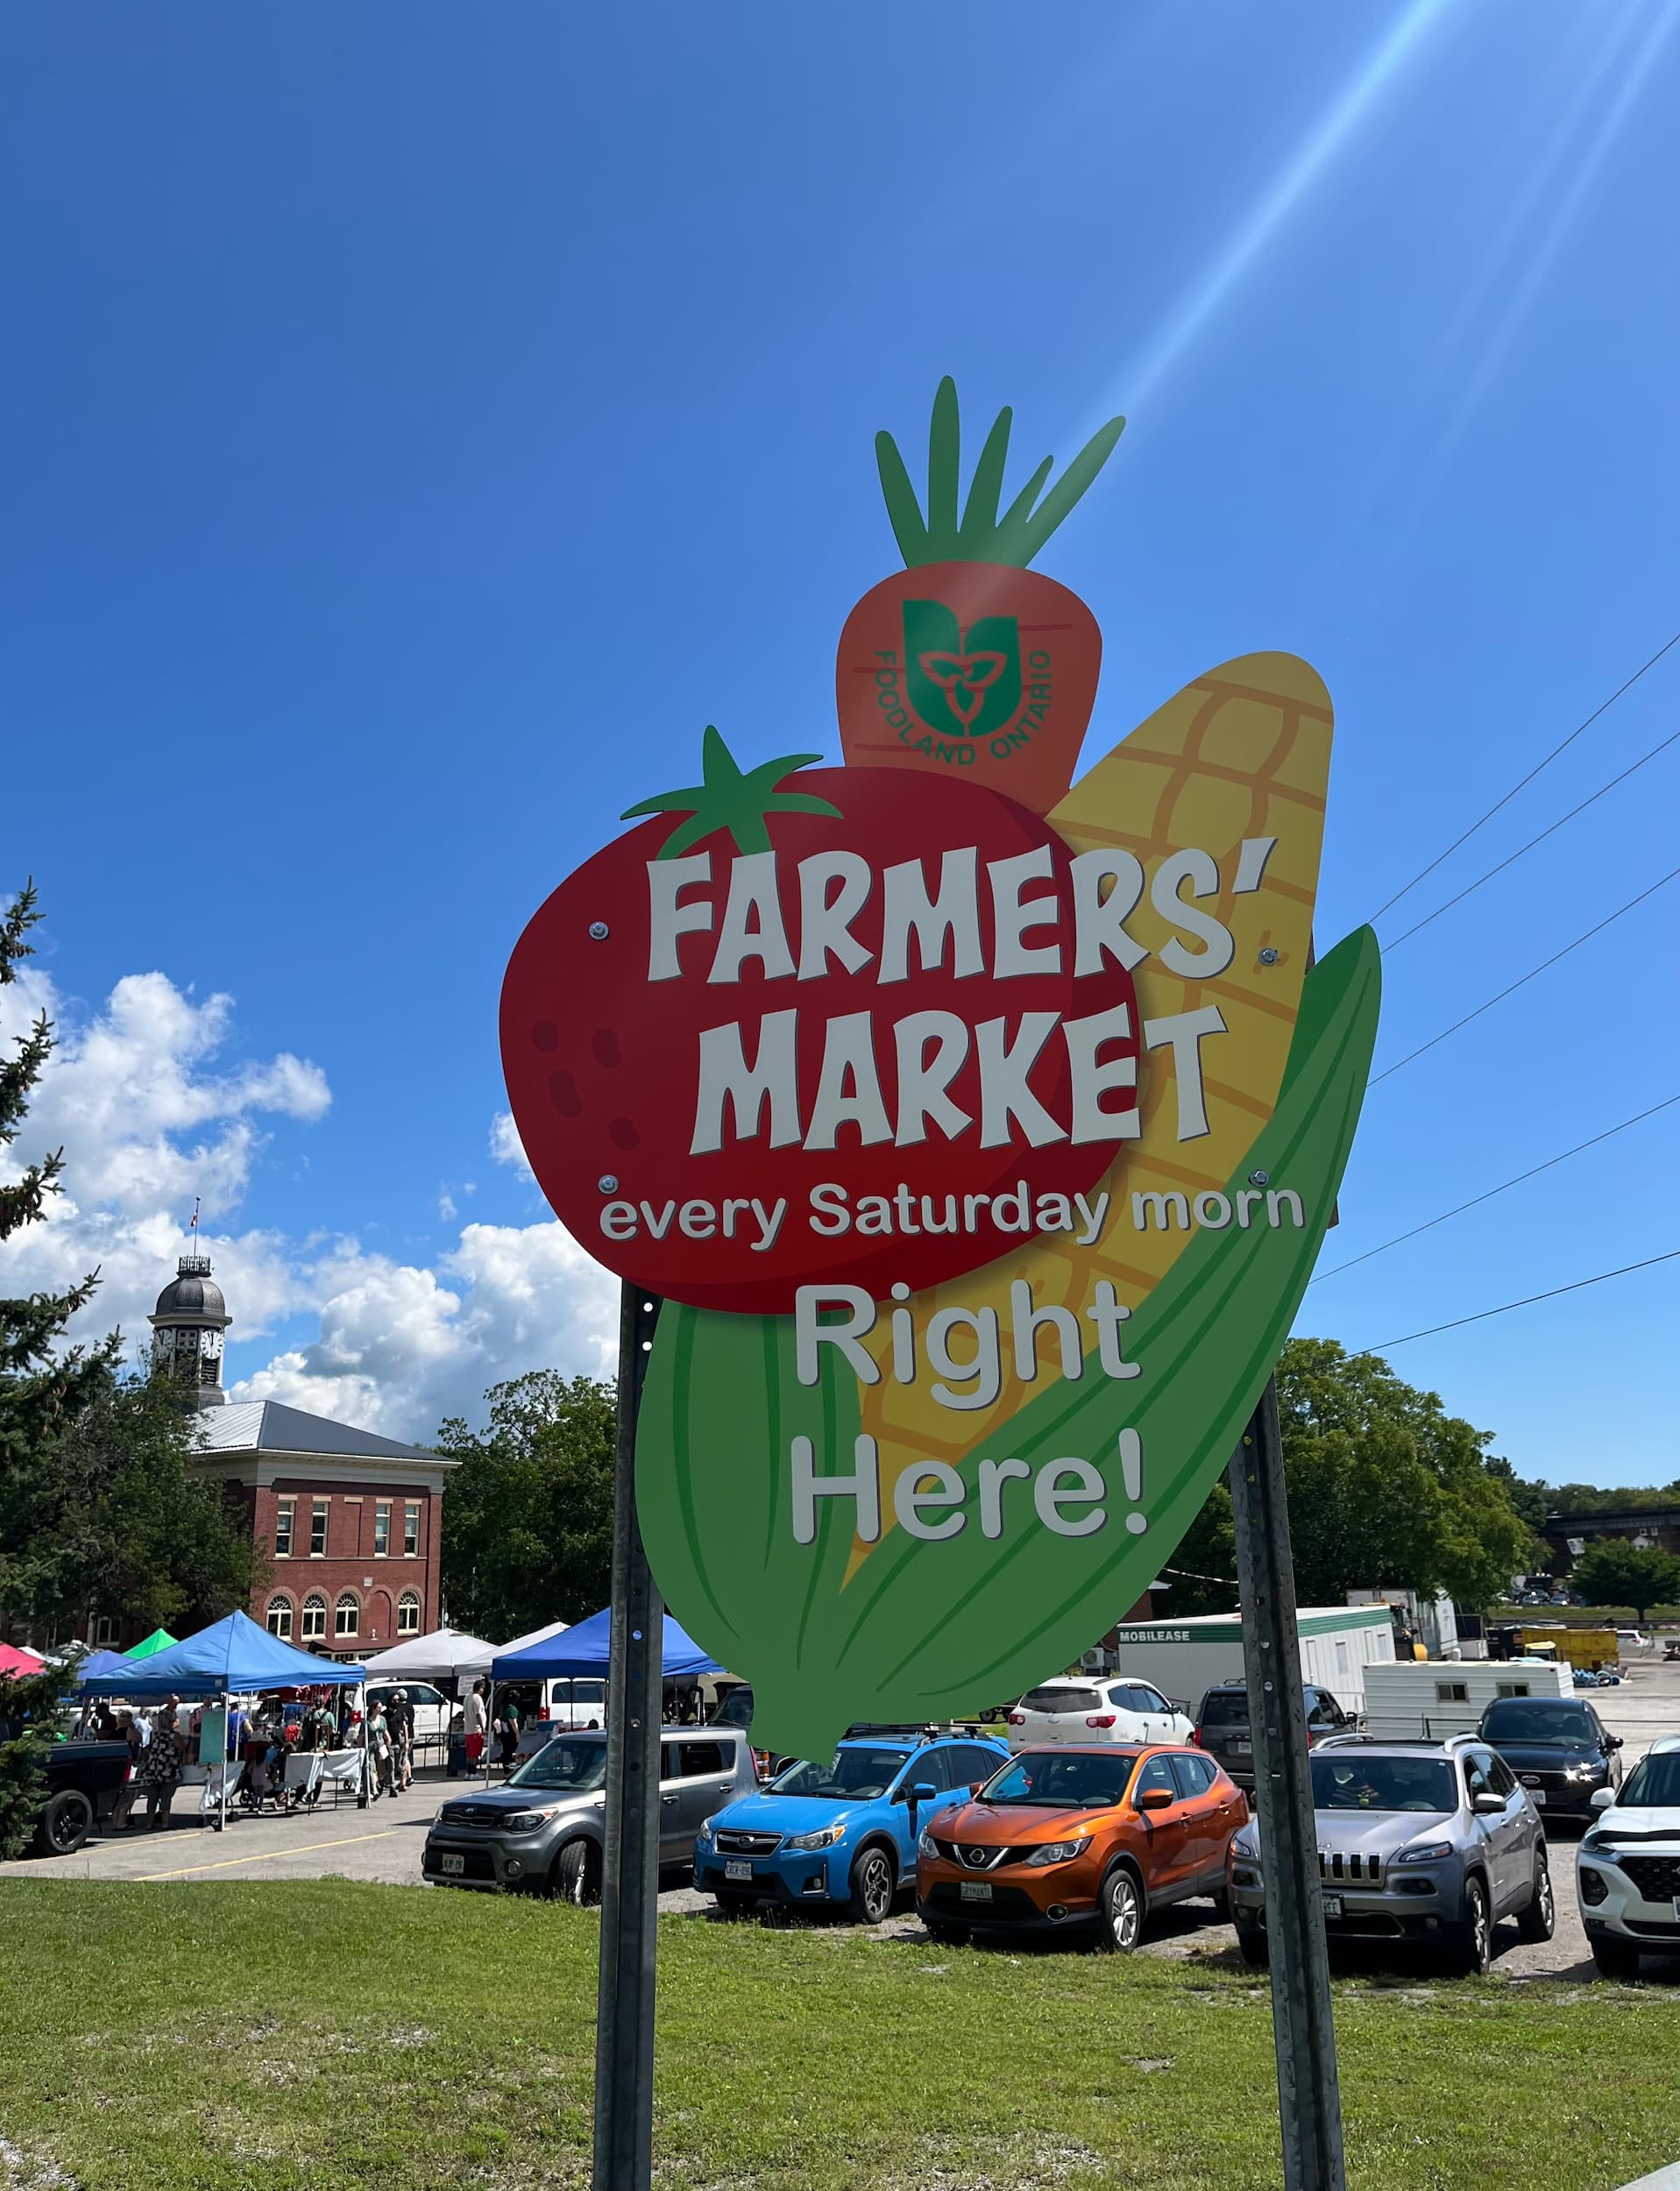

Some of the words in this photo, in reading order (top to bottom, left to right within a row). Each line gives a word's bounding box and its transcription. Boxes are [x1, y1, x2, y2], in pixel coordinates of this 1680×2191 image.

[875, 650, 977, 766] FOODLAND
[989, 649, 1053, 760] ONTARIO
[646, 837, 1278, 985] FARMERS'
[689, 1002, 1229, 1155] MARKET
[599, 1196, 787, 1252] every
[809, 1180, 1109, 1245] Saturday
[1132, 1188, 1306, 1232] morn
[794, 1279, 1144, 1411] Right
[790, 1428, 1150, 1545] Here!
[1119, 1630, 1191, 1641] MOBILEASE
